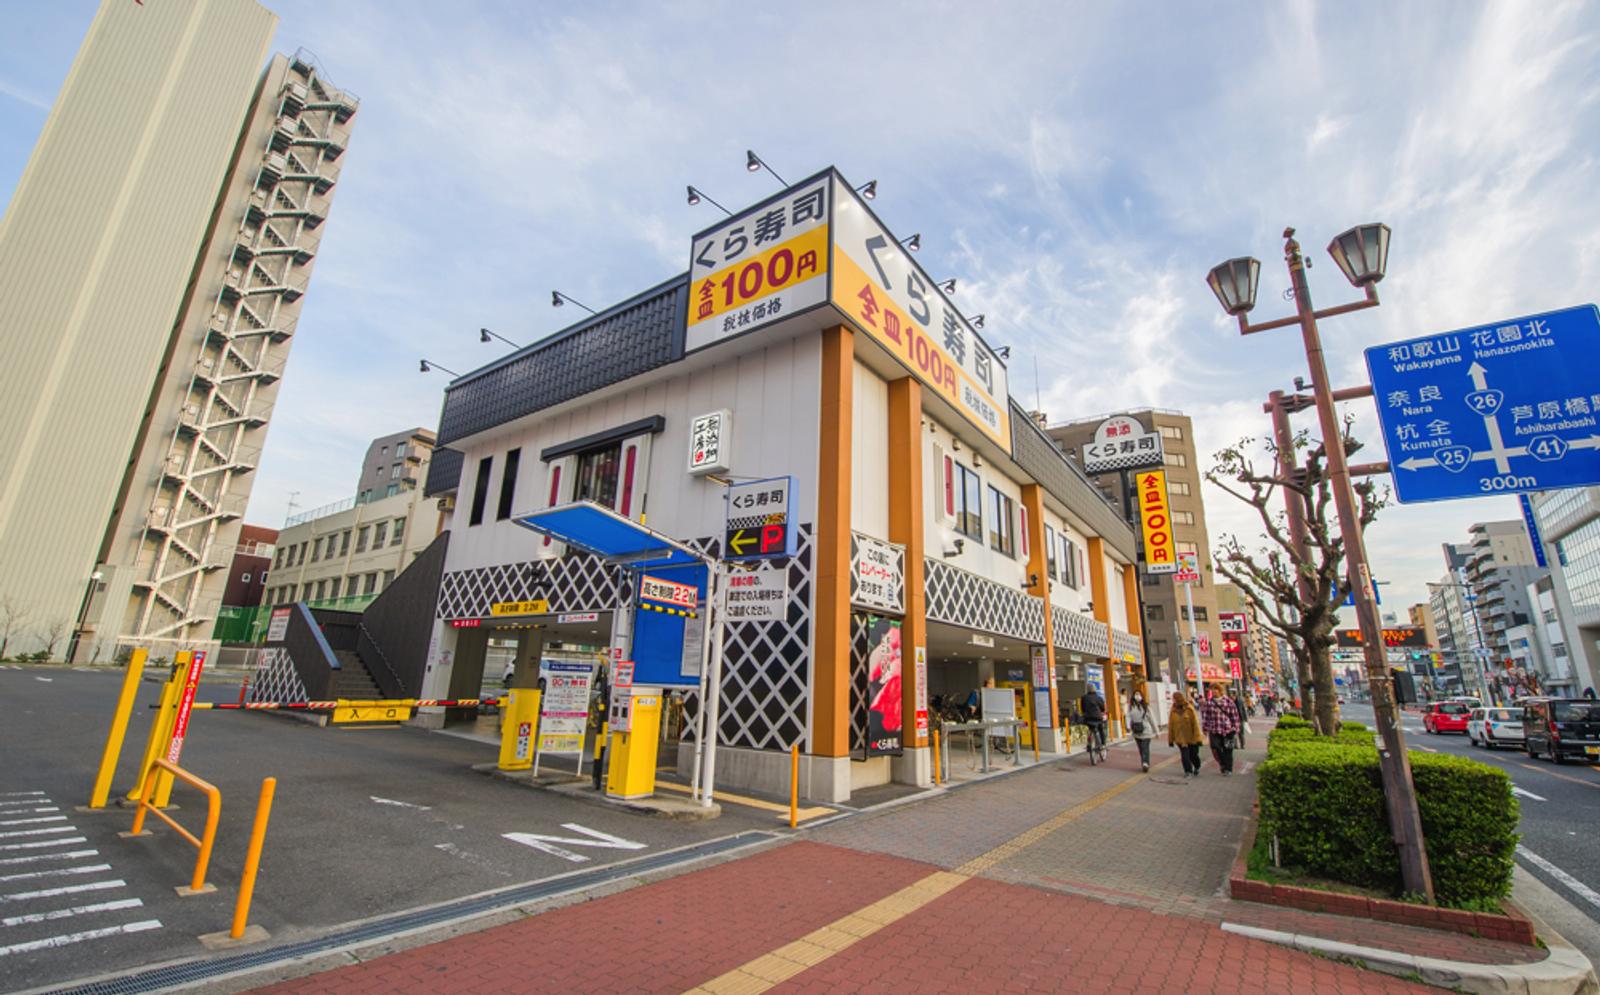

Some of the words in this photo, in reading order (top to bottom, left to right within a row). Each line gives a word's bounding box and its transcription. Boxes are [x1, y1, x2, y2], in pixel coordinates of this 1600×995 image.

[695, 186, 825, 268] くら寿司
[722, 297, 783, 332] 税抜価格
[865, 234, 994, 396] くら寿司
[857, 283, 957, 398] 全皿100円
[1388, 336, 1461, 363] 和歌山
[1469, 319, 1550, 349] 花園北
[1393, 354, 1462, 374] Wakayama
[1473, 337, 1555, 360] Hanazonokita
[1387, 385, 1443, 408] 奈良
[1474, 394, 1497, 410] 26
[1402, 405, 1433, 417] Nara
[1395, 419, 1452, 441] 杭全
[1515, 416, 1597, 436] Ashiharabashi
[1088, 437, 1155, 458] くら寿司
[1401, 438, 1452, 452] Kumata
[1536, 440, 1561, 456] 41
[1442, 450, 1465, 465] 25
[1480, 475, 1537, 492] 300m
[732, 490, 784, 509] くら寿司
[762, 525, 784, 554] P
[350, 708, 398, 720] 入口
